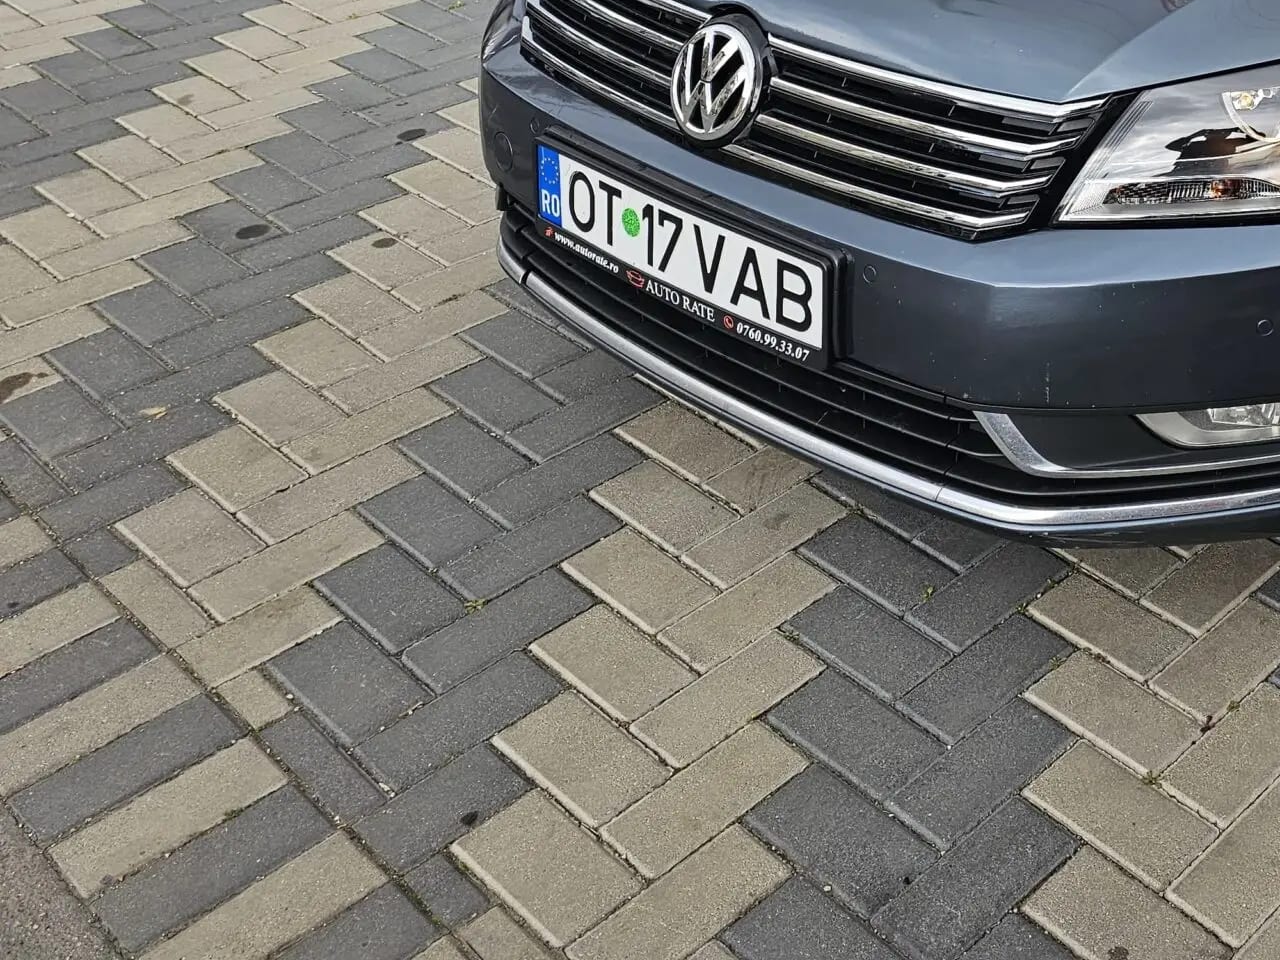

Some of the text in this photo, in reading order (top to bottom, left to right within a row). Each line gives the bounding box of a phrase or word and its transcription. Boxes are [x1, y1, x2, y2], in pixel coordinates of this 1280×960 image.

[541, 188, 561, 218] RO
[568, 170, 623, 247] OT
[554, 232, 619, 274] www.autorate.ro
[645, 279, 716, 322] AUTO RATE
[736, 321, 810, 362] 0760.99.33.07
